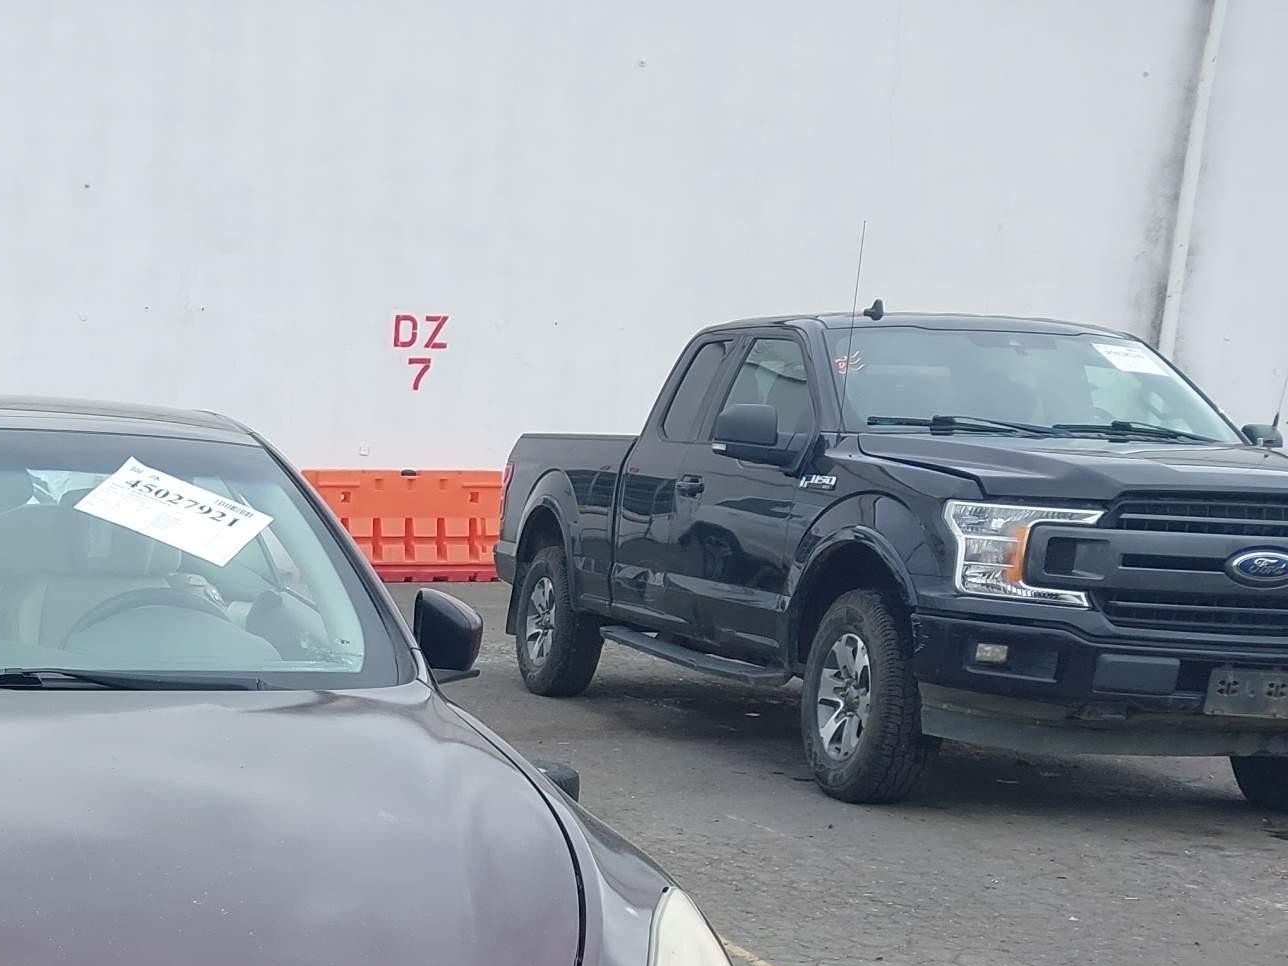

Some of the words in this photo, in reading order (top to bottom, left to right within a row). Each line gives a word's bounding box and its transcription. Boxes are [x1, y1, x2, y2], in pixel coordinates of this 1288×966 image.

[393, 314, 449, 349] DZ
[408, 357, 432, 391] 7
[125, 479, 240, 527] 45027921
